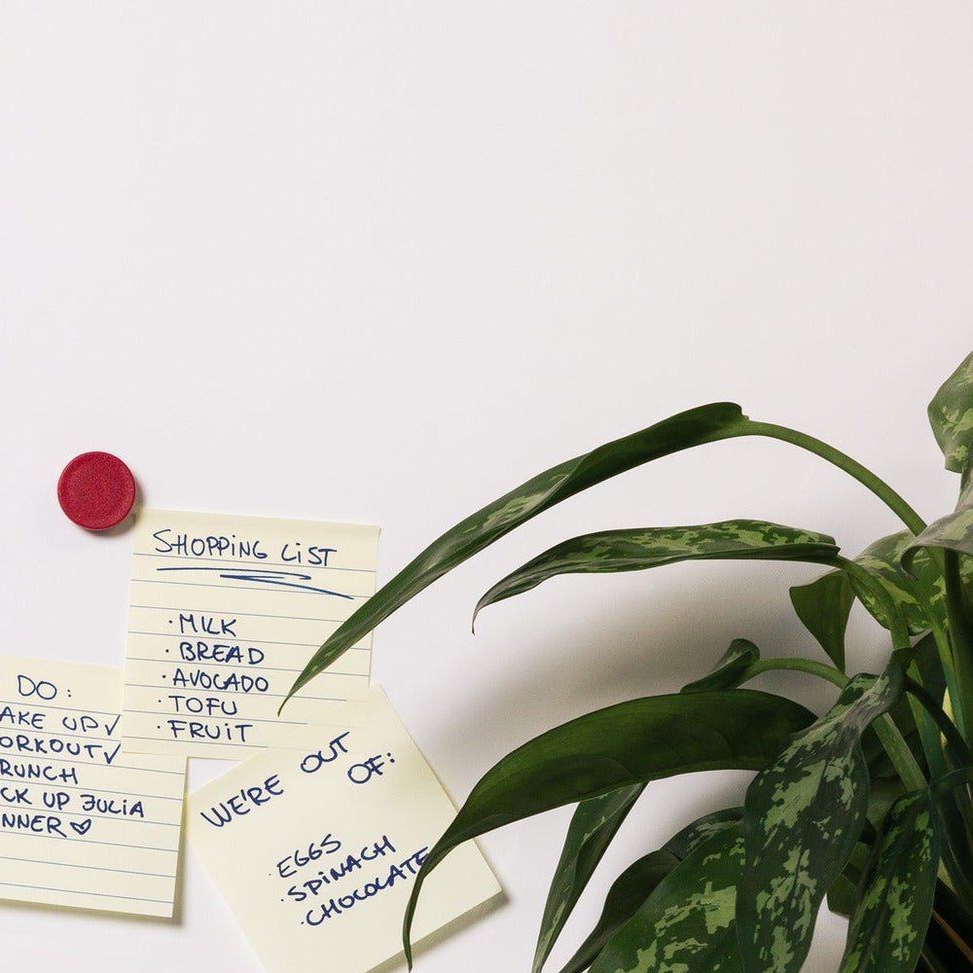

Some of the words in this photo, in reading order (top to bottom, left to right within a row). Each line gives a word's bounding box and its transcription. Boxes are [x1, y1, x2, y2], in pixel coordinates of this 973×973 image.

[178, 612, 238, 637] MILK
[178, 641, 266, 665] BREAD
[172, 667, 270, 693] AVOCADO
[167, 694, 238, 716] TOFU
[62, 715, 100, 733] UP
[200, 774, 285, 828] WE'RE
[300, 731, 350, 773] OUT
[42, 791, 71, 811] UP
[277, 833, 342, 878] EGGS
